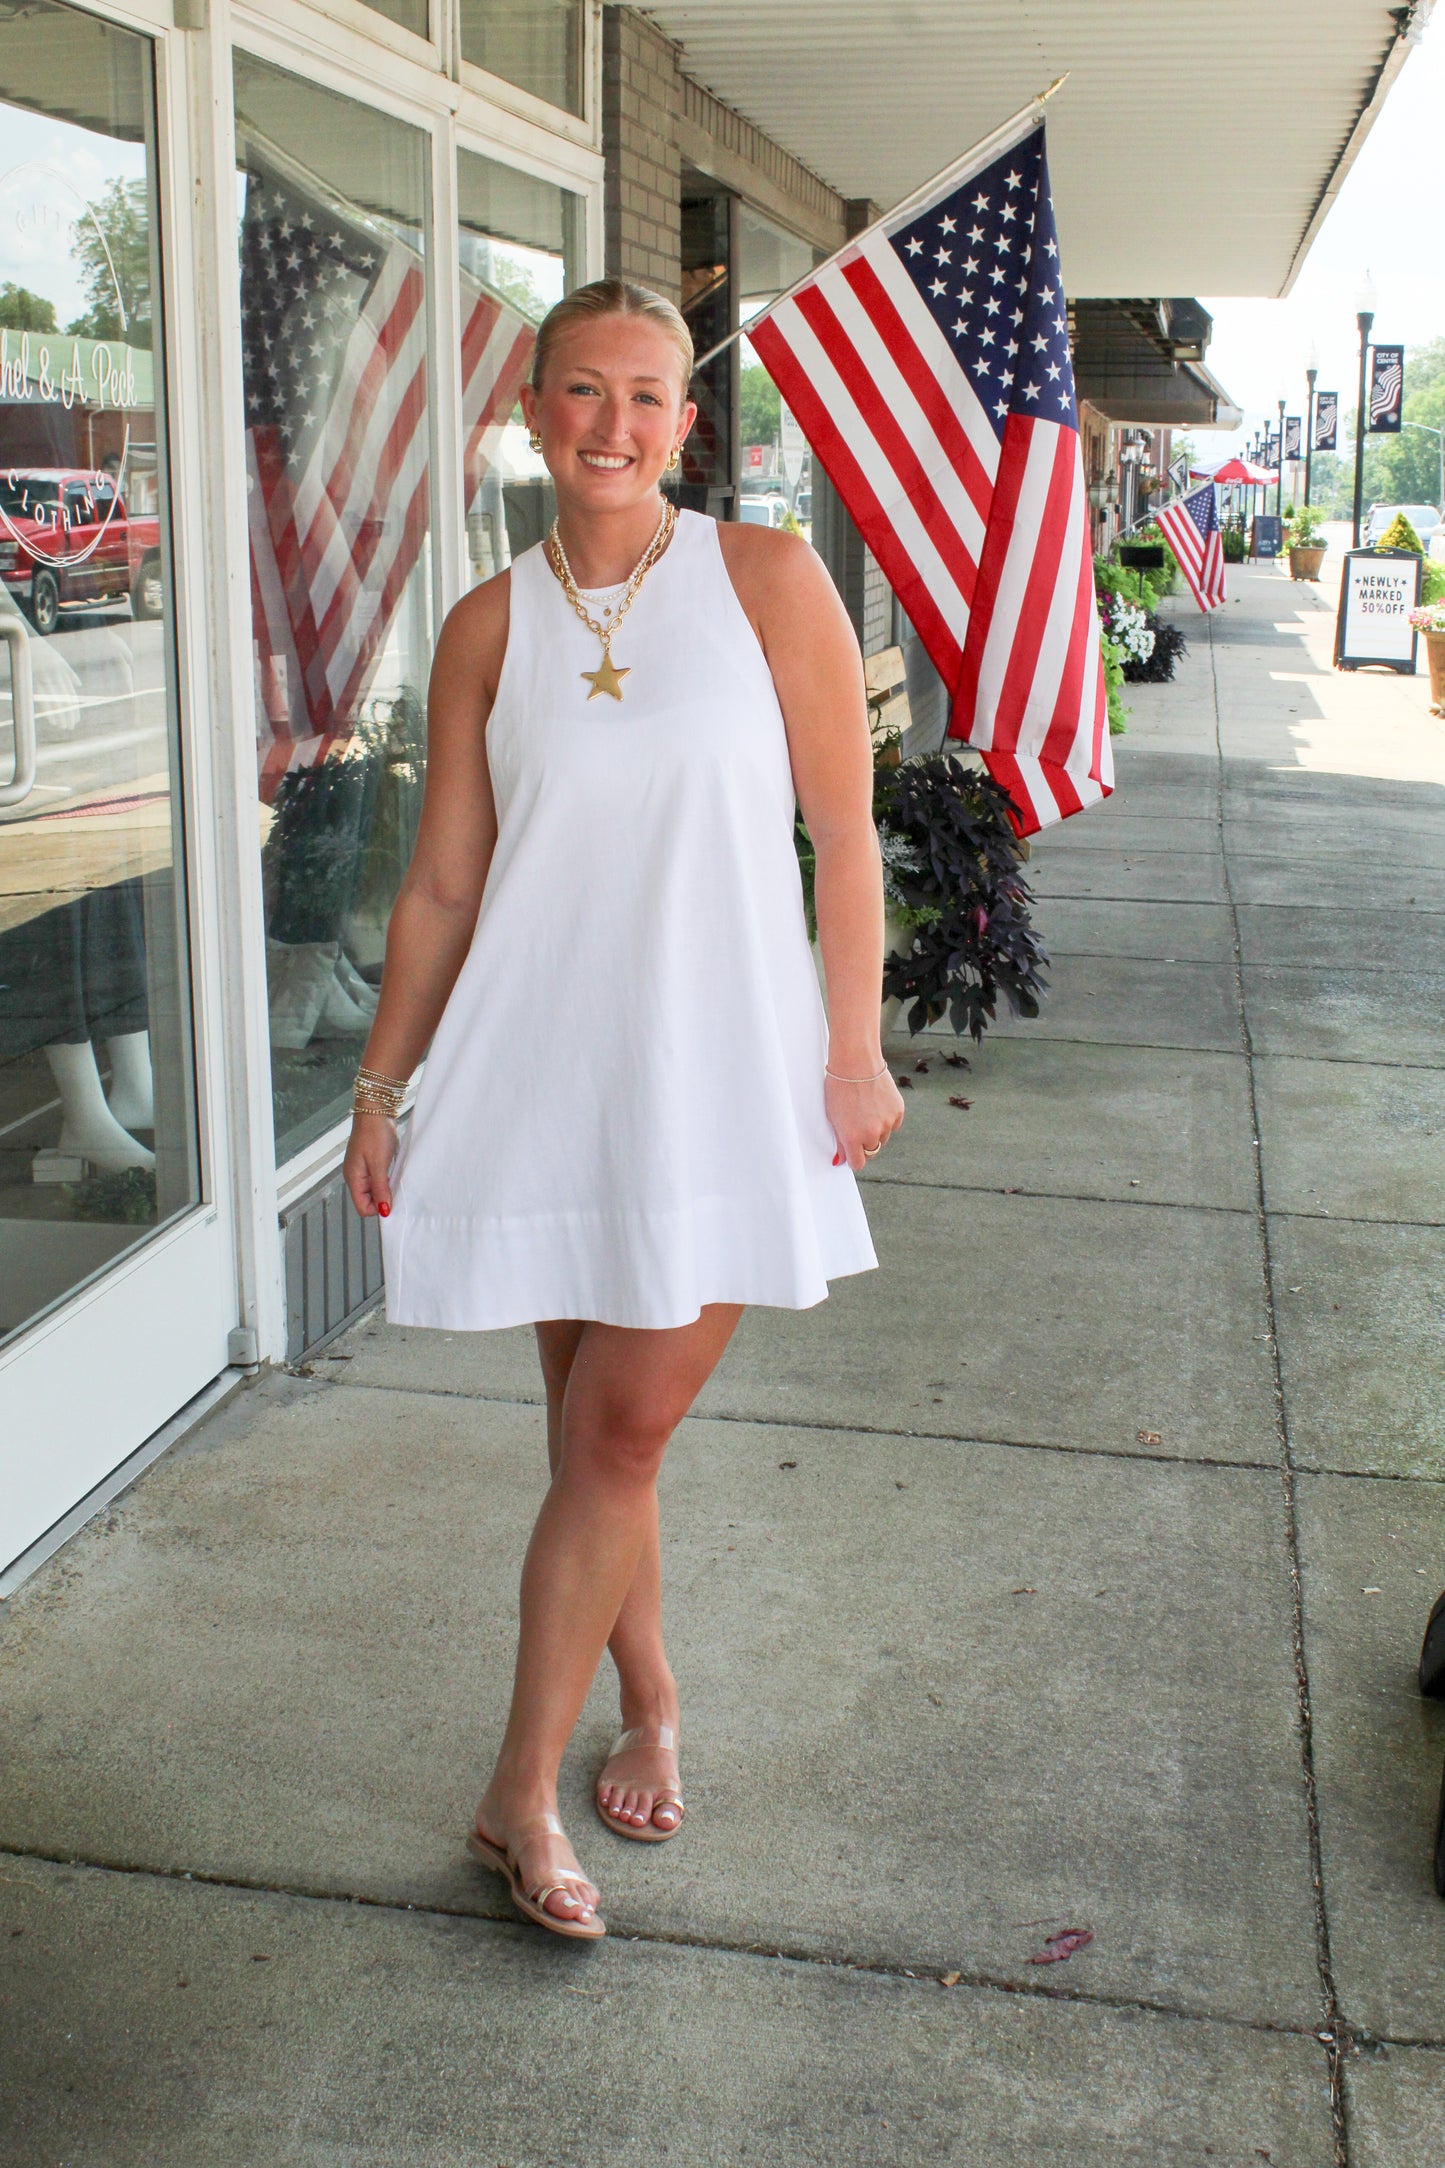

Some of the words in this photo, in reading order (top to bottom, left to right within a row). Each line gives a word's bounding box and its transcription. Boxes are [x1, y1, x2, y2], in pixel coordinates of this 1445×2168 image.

[0, 329, 33, 399] hel
[40, 346, 59, 400] &
[61, 342, 88, 410] A
[91, 342, 138, 409] Peck
[8, 468, 105, 532] CLOTHING
[1359, 589, 1403, 601] MARKED
[1362, 576, 1399, 588] NEWLY
